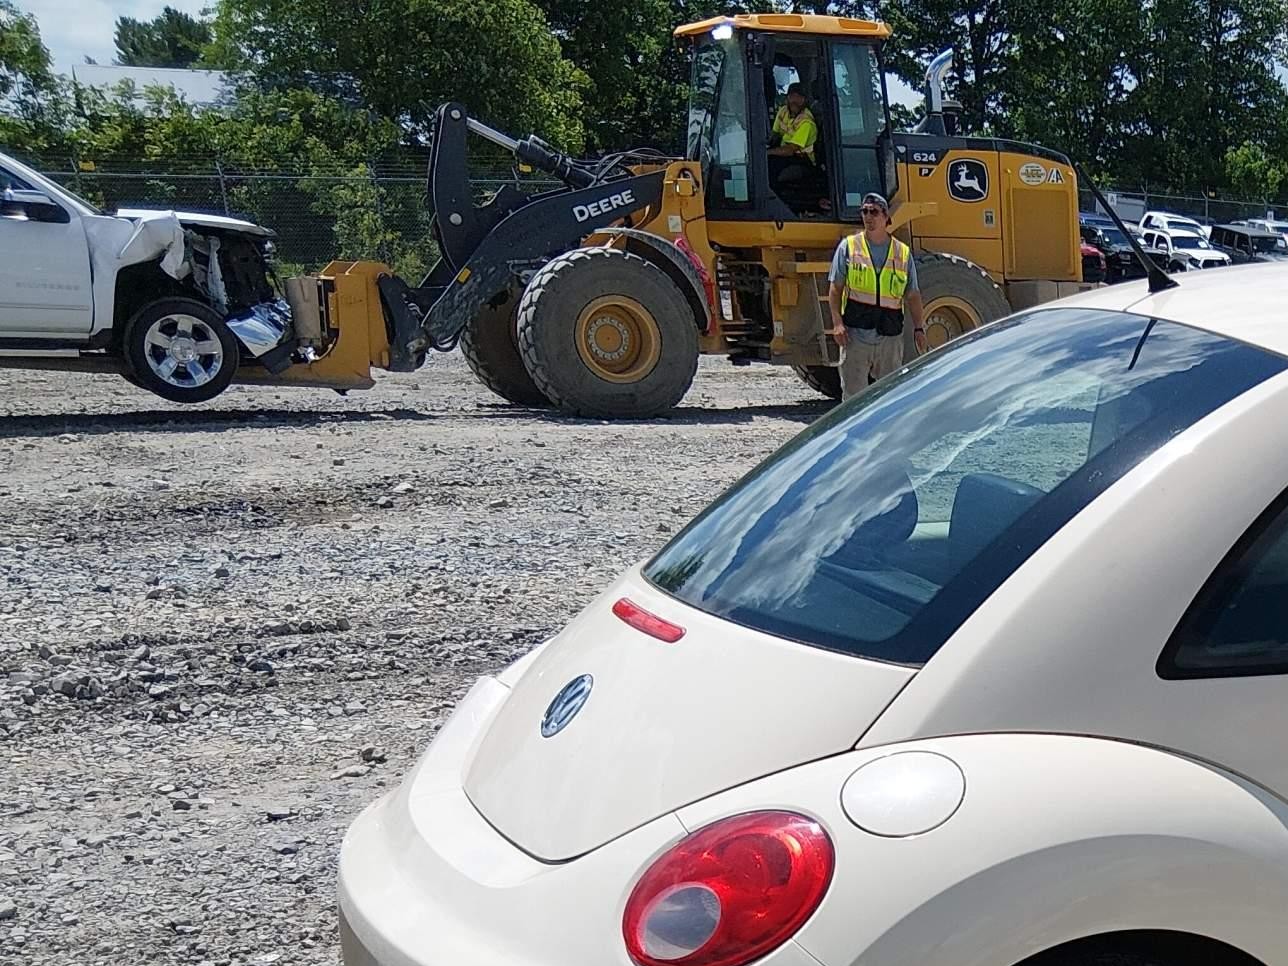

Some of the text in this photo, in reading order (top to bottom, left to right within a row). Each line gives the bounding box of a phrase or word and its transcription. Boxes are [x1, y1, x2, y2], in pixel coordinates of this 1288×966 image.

[913, 152, 937, 162] 624
[921, 168, 929, 176] P
[572, 189, 636, 223] DEERE
